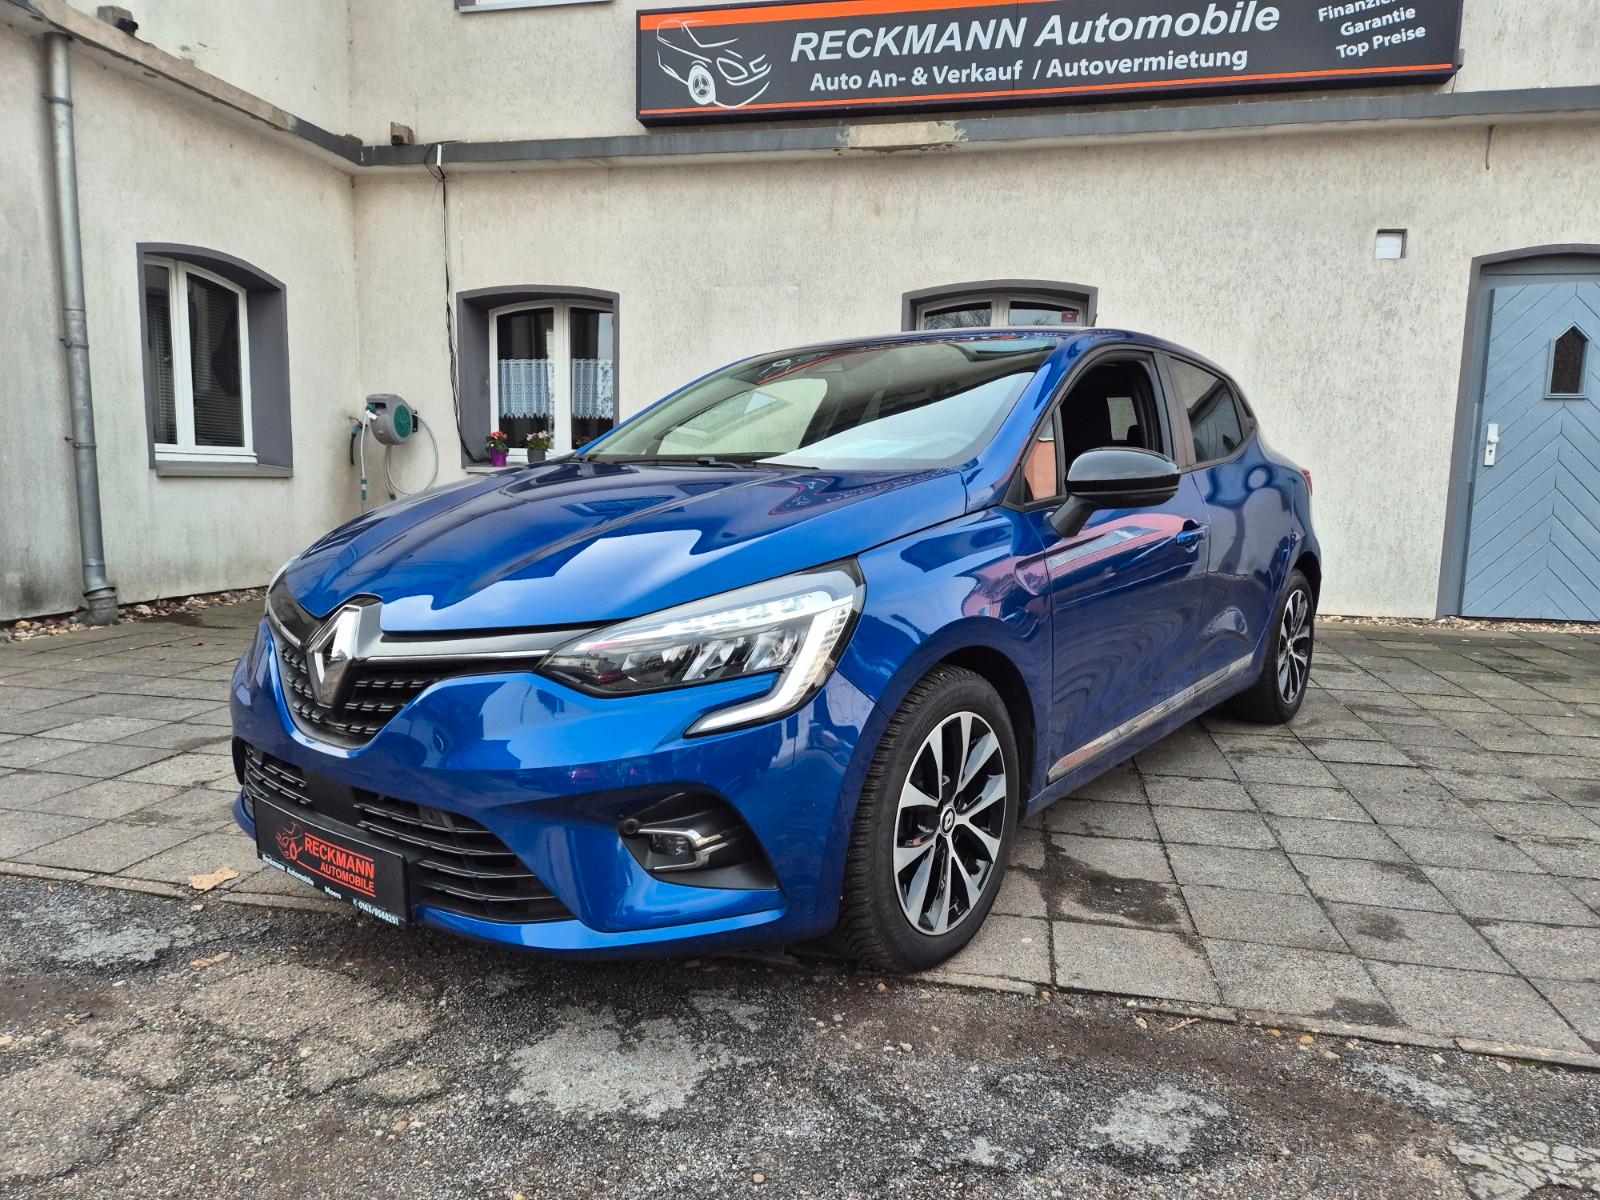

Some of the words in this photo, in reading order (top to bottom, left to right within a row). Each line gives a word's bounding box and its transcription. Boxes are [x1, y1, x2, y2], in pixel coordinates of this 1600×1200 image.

[791, 16, 1028, 62] RECKMANN
[1033, 0, 1280, 47] Automobile
[1340, 7, 1416, 36] Garantie
[1336, 41, 1369, 58] Top
[1372, 26, 1426, 50] Preise
[810, 70, 862, 92] Auto
[868, 66, 906, 88] An-
[911, 66, 928, 86] &
[932, 60, 1023, 85] Verkauf
[1046, 48, 1248, 78] Autovermietung
[305, 837, 375, 879] RECKMANN
[320, 862, 375, 892] AUTOMOBILE
